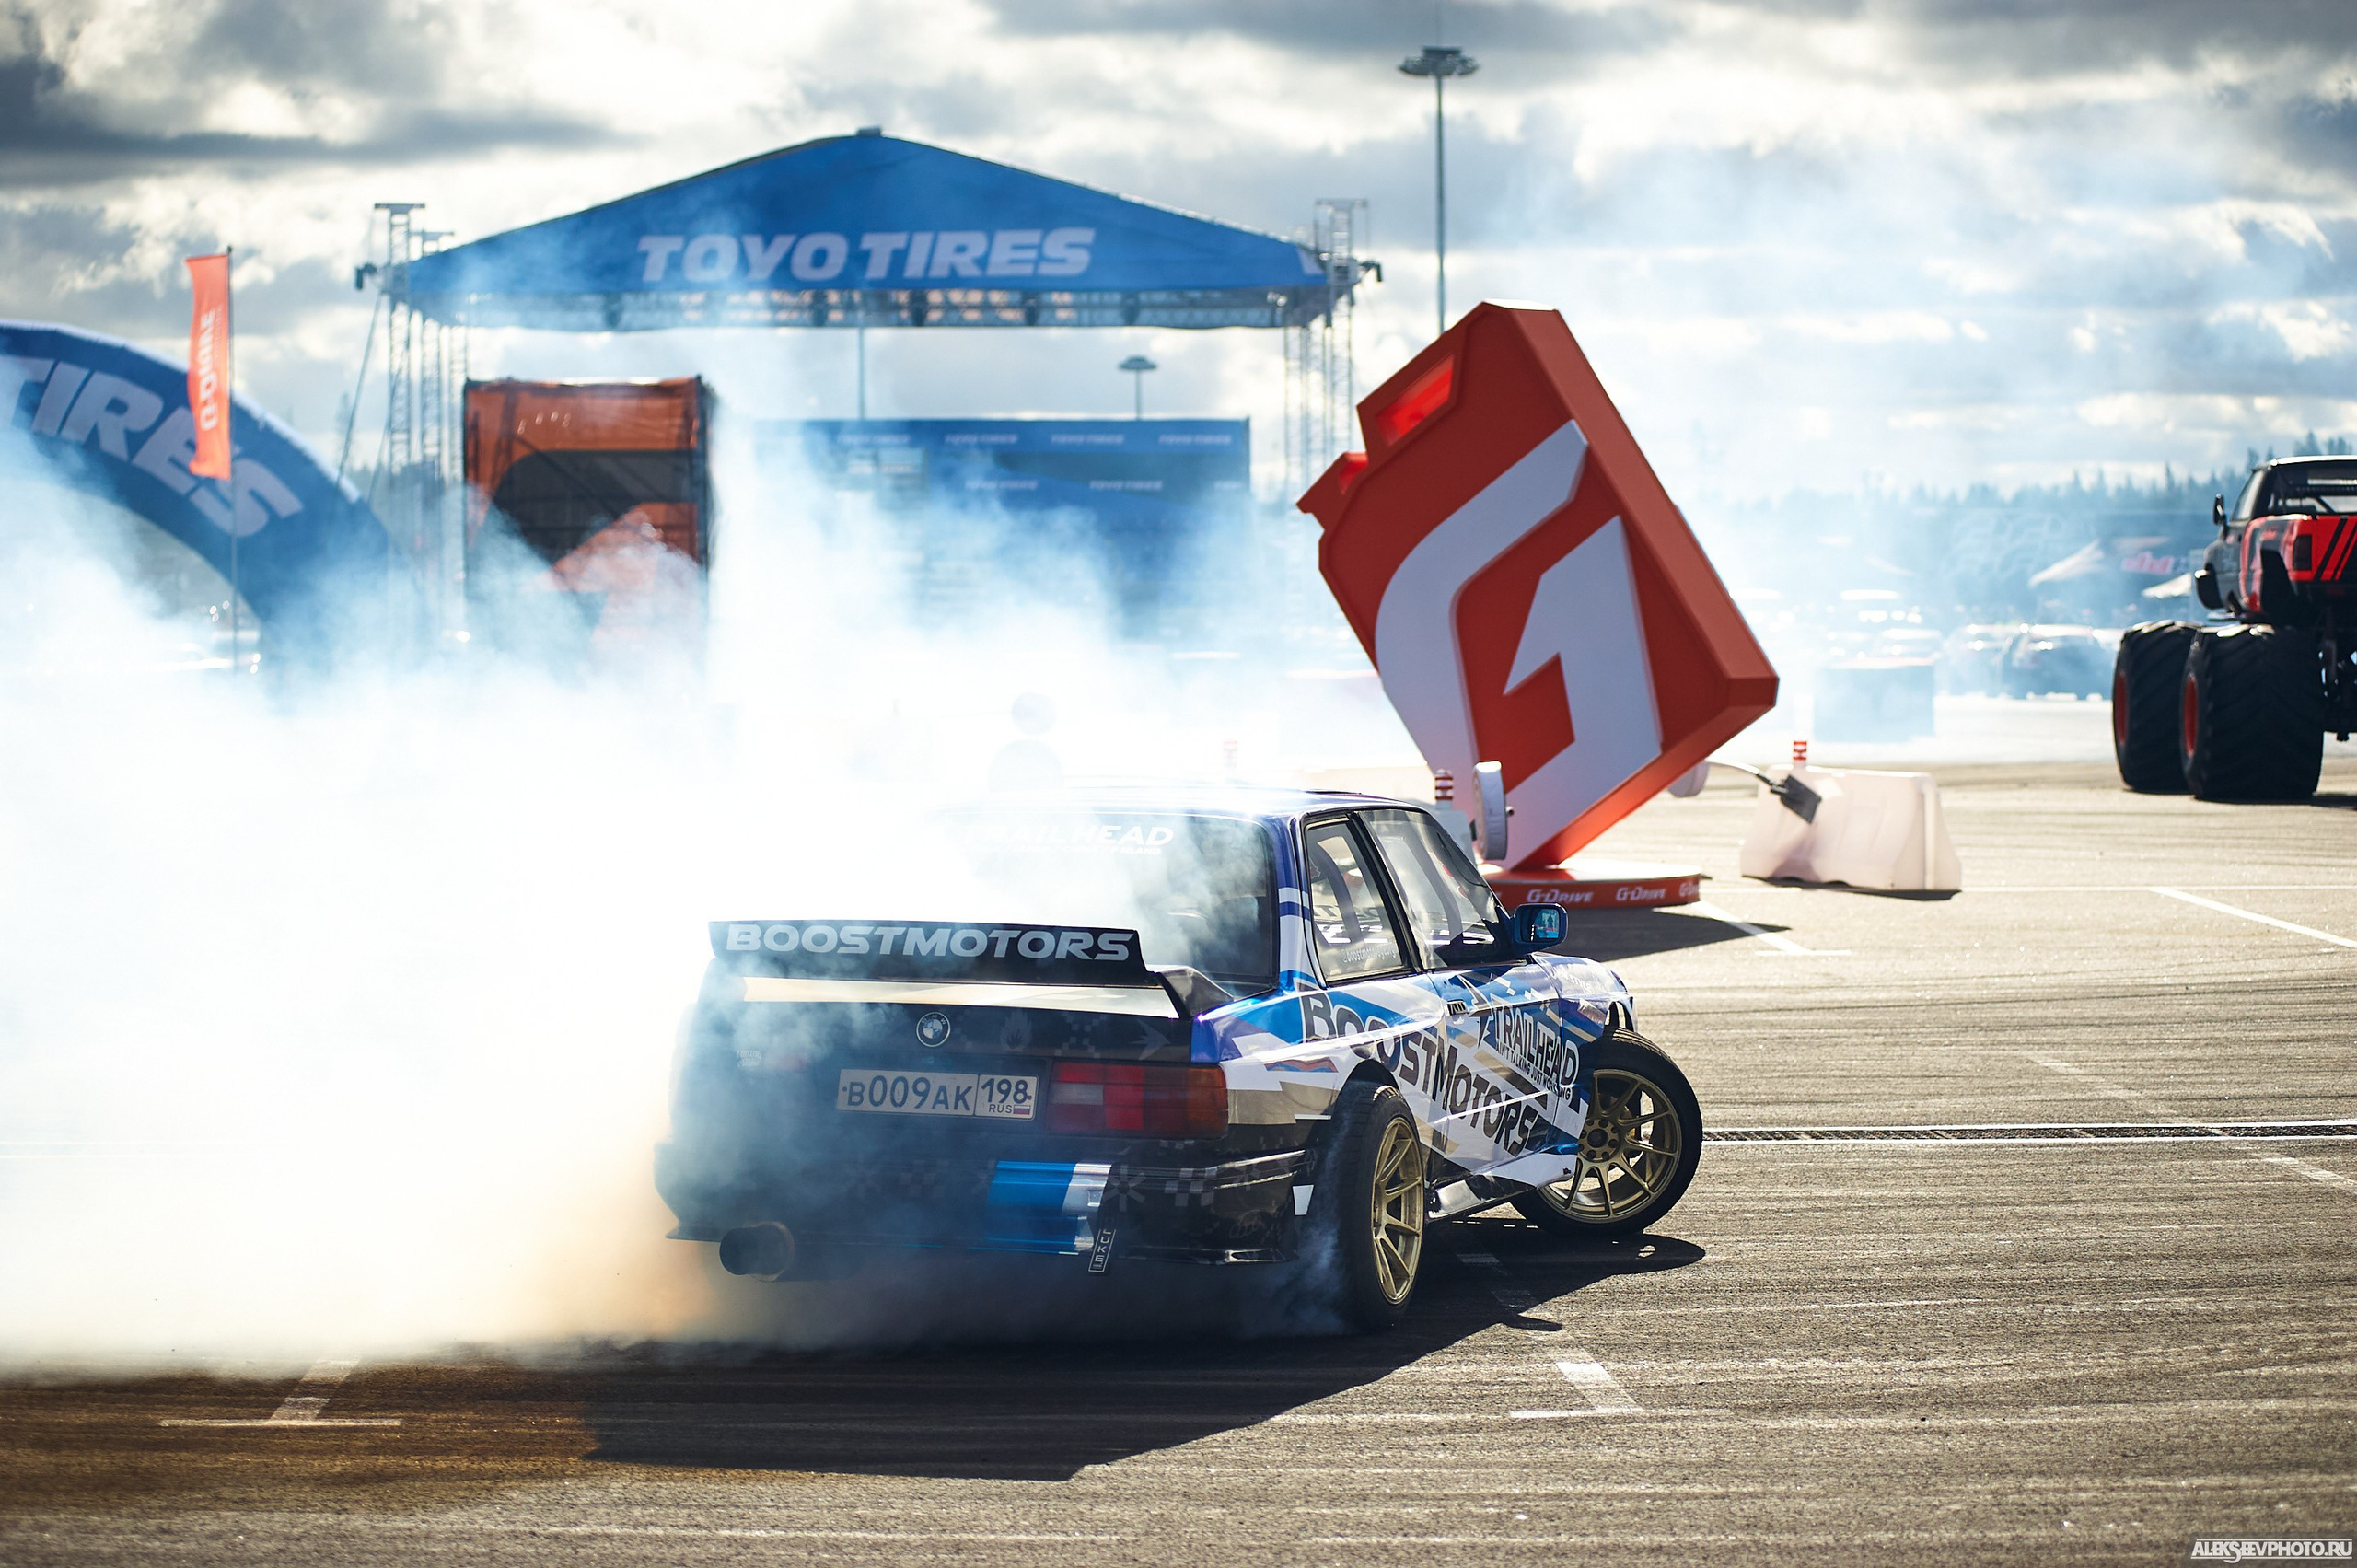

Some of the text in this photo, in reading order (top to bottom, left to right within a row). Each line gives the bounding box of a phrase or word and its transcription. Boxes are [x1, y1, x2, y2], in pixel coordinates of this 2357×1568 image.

[637, 227, 1096, 283] TOYO TIRES
[0, 352, 303, 538] TIRES
[726, 924, 1133, 961] BOOSTMOTORS
[1297, 983, 1538, 1157] BOOSTMOTORS
[1493, 1005, 1579, 1086] TRAILHEAD
[981, 1078, 1019, 1104] 198
[988, 1104, 1012, 1114] RUS
